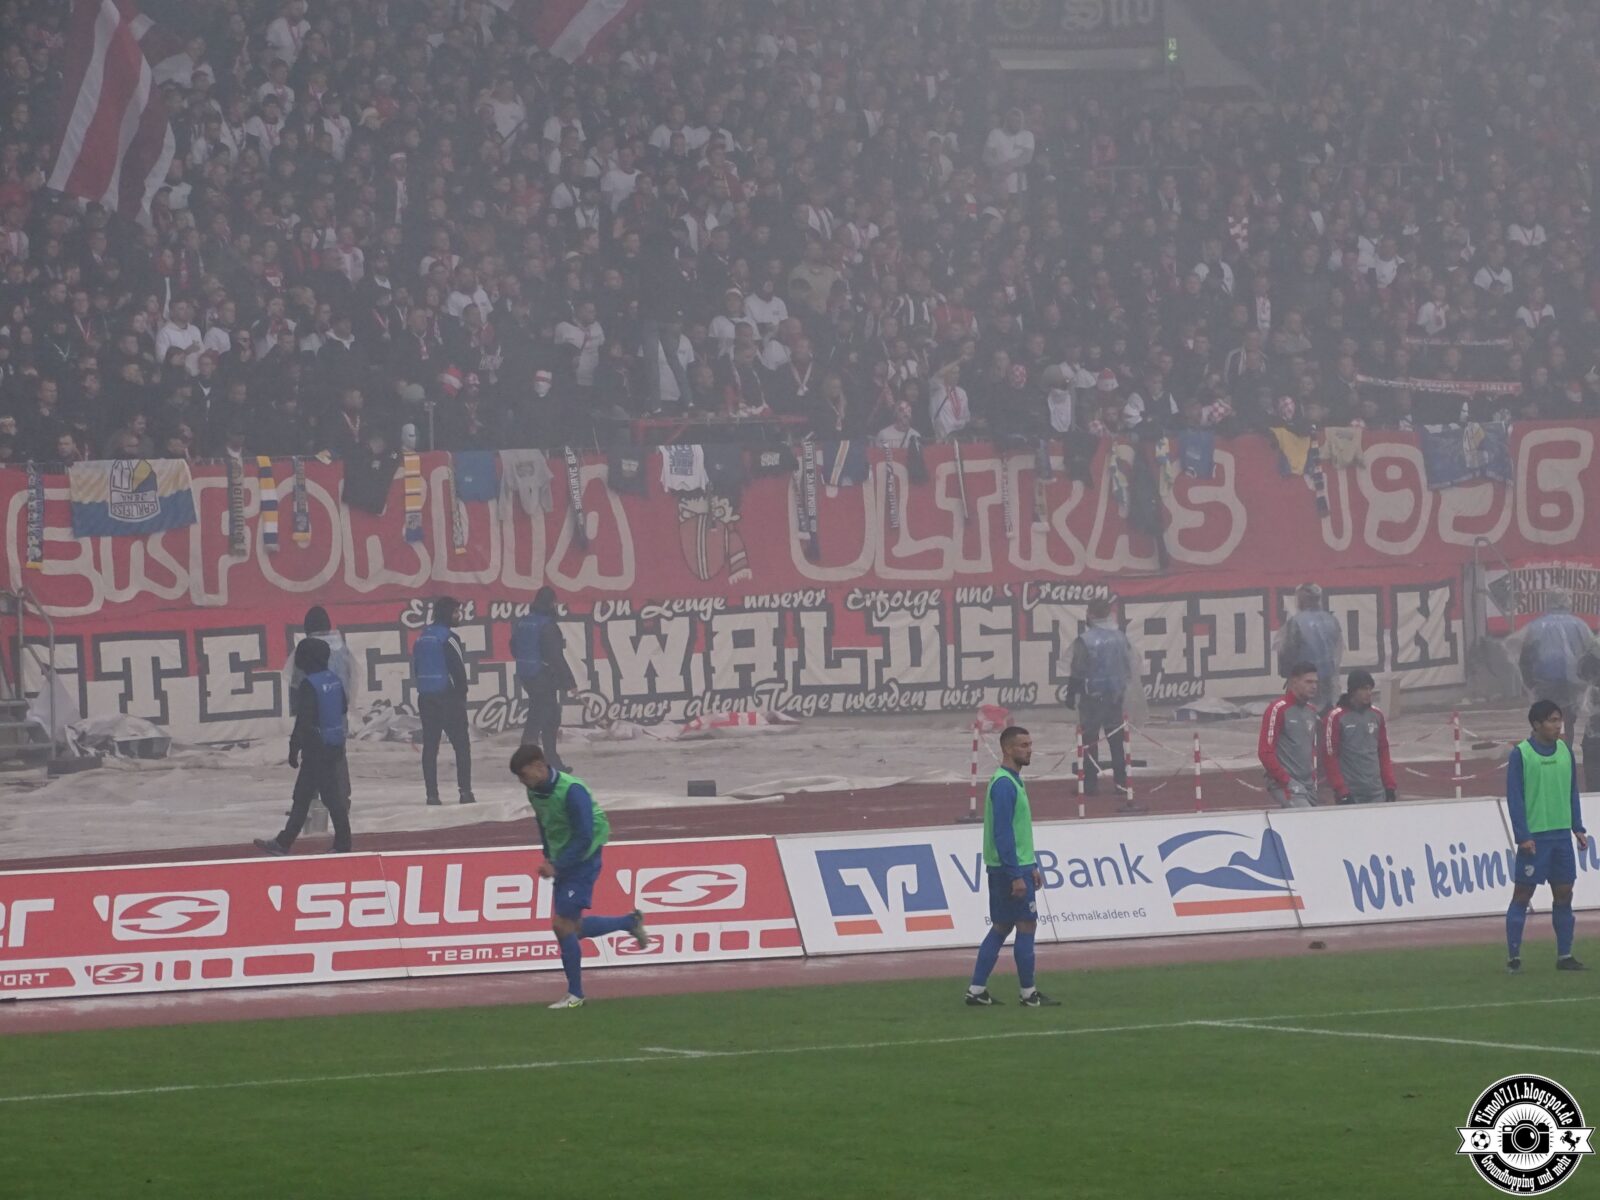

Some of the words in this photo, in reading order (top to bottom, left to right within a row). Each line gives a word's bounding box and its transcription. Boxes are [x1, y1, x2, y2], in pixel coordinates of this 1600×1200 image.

[846, 587, 942, 618] Erfolge
[844, 678, 927, 710] werden
[942, 685, 983, 706] wir
[1000, 684, 1037, 704] uns
[1342, 853, 1416, 913] Wir
[1061, 909, 1130, 923] Schmalkalden
[1132, 907, 1147, 919] eG
